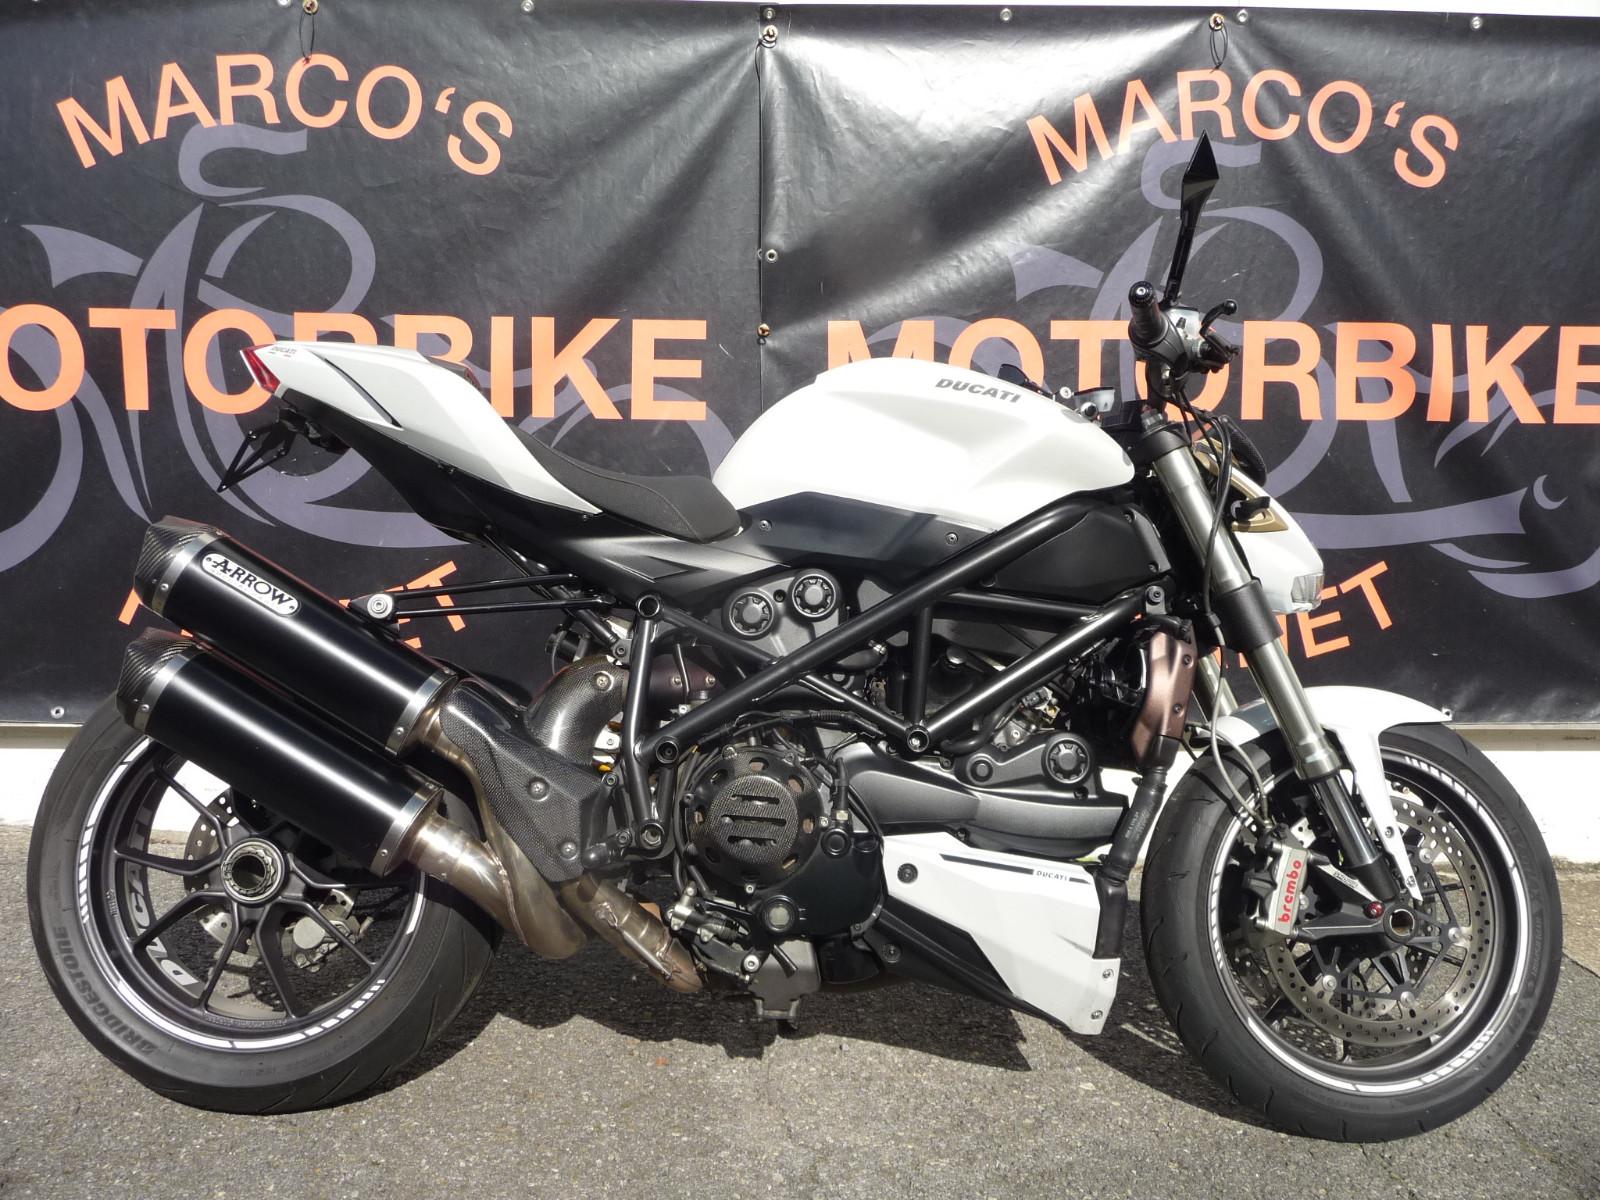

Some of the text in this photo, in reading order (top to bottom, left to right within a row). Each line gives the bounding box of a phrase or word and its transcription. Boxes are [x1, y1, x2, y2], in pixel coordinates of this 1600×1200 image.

[56, 53, 513, 176] MARCO'S
[1027, 68, 1460, 189] MARCO'S
[935, 378, 1022, 403] DUCATI
[211, 558, 294, 605] ARROW
[1036, 870, 1068, 881] DUCATI
[1278, 860, 1302, 923] brembo
[53, 926, 158, 1054] BRIDGESTONE
